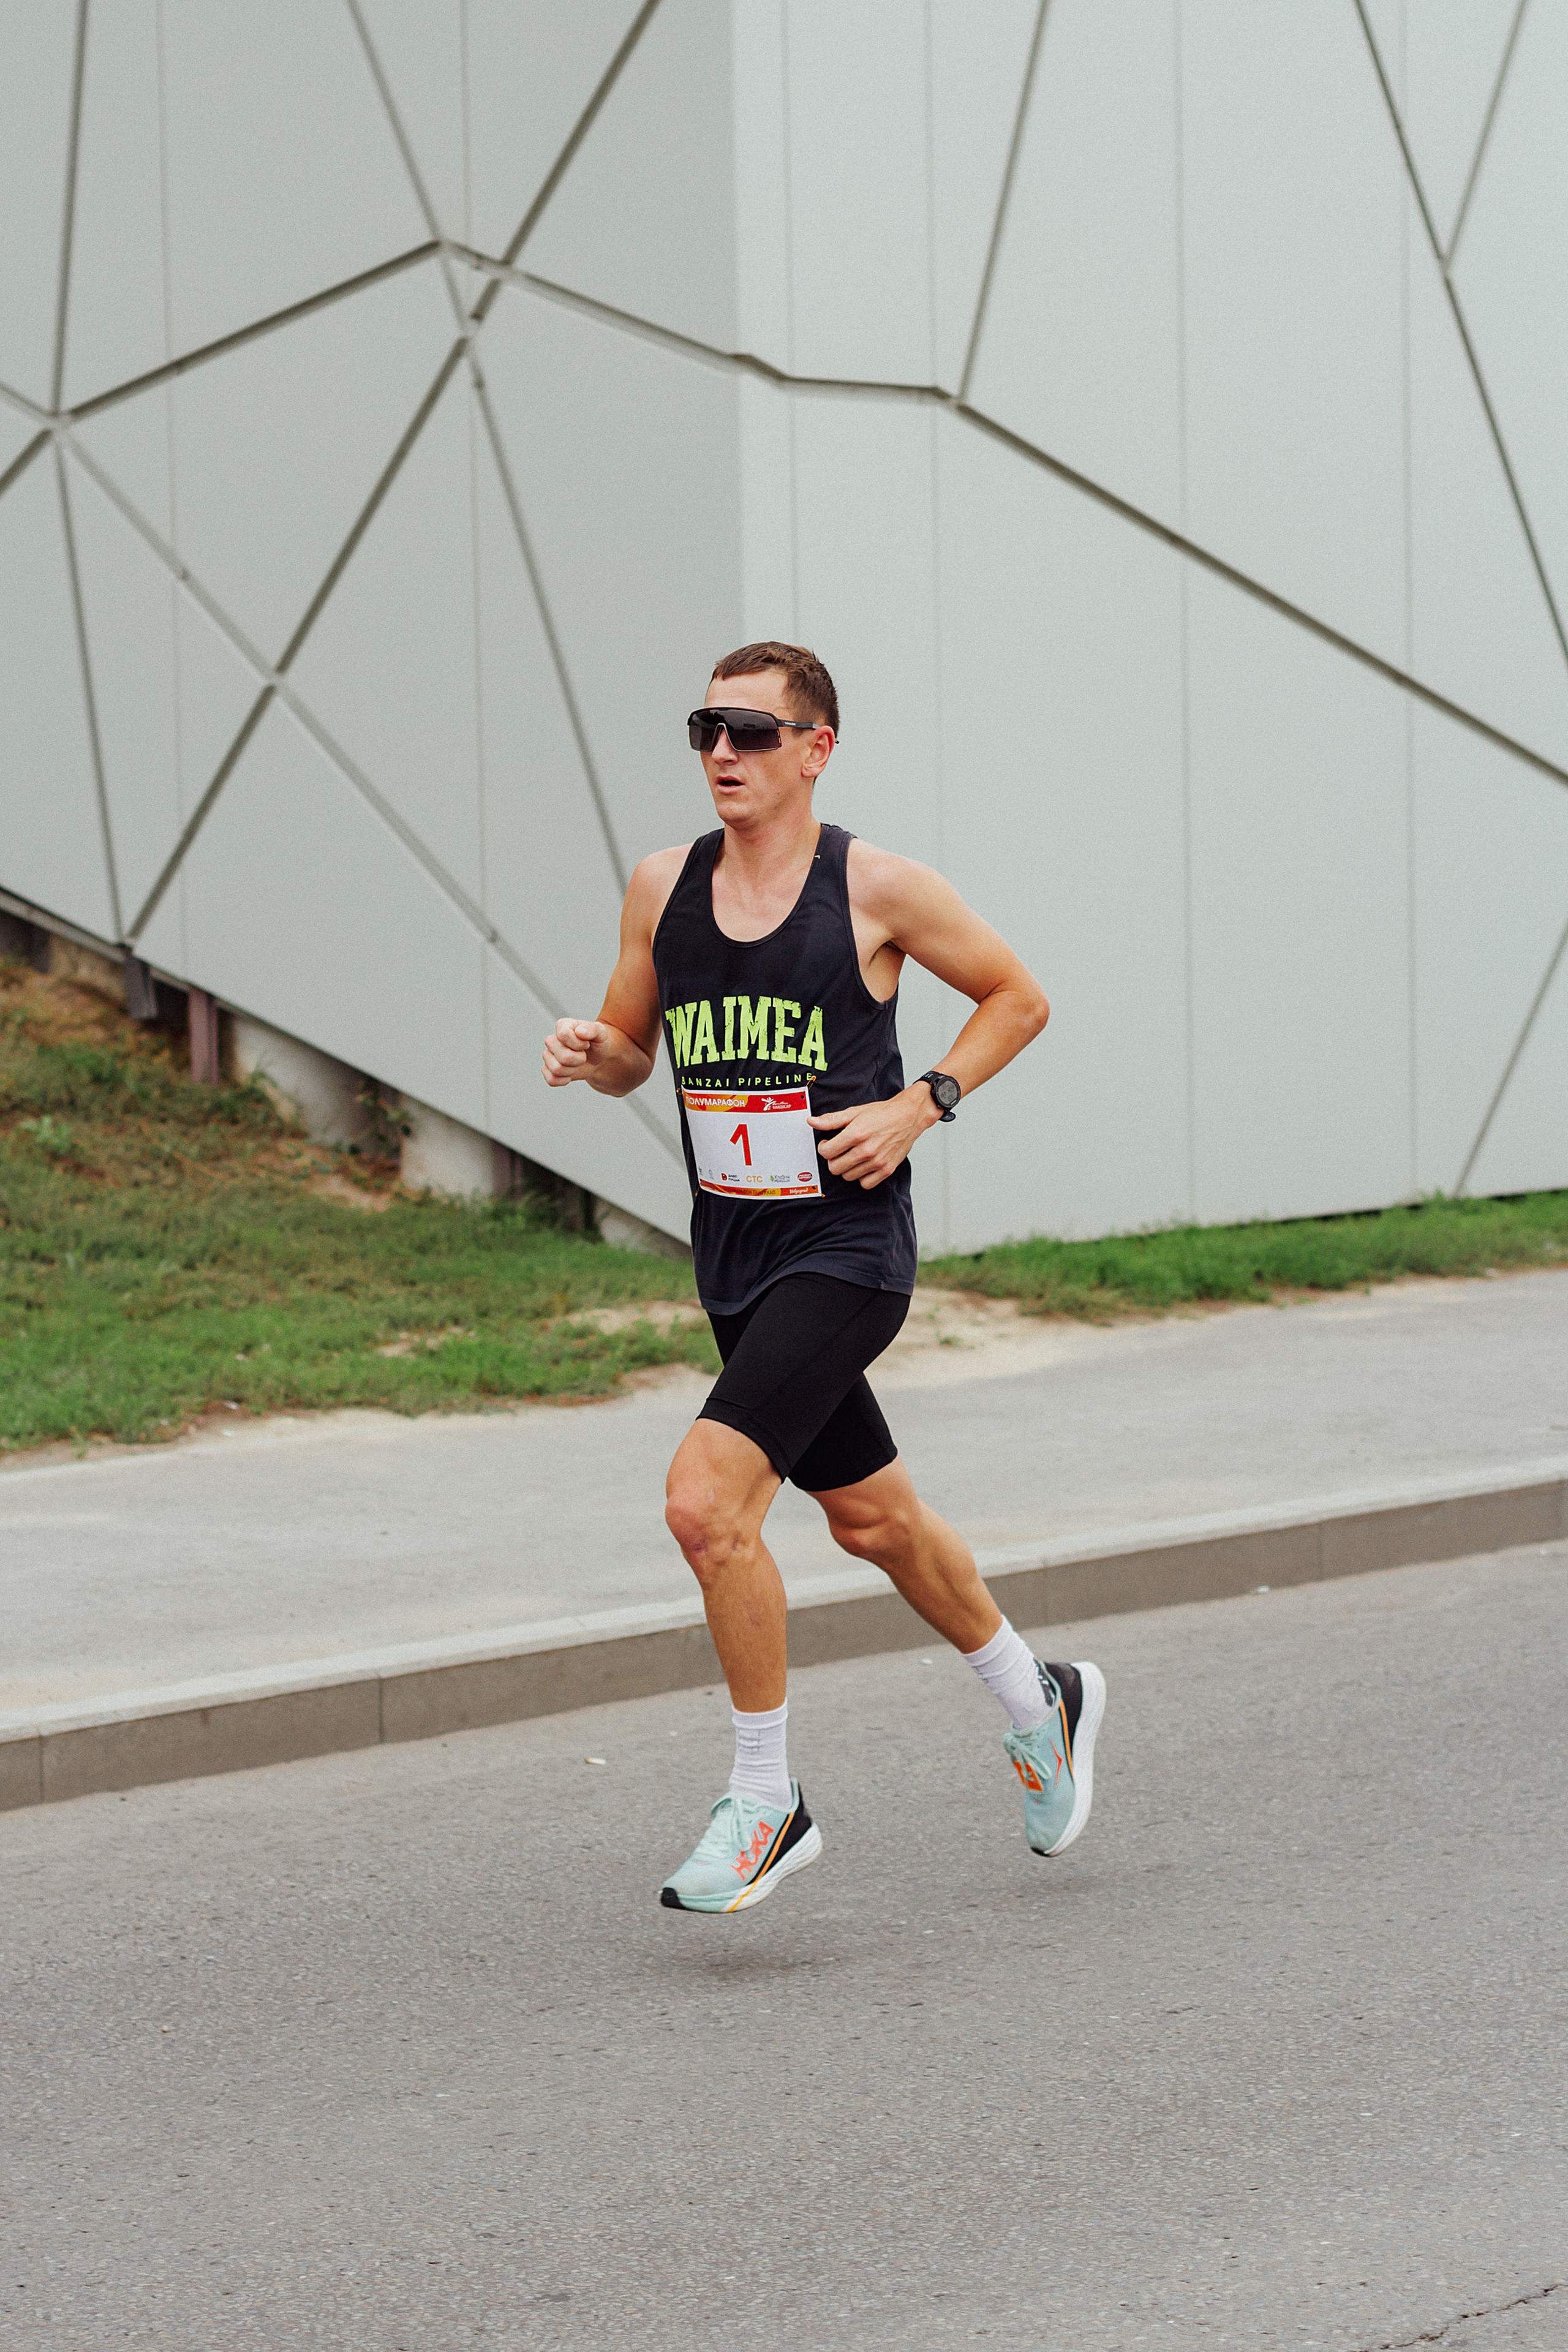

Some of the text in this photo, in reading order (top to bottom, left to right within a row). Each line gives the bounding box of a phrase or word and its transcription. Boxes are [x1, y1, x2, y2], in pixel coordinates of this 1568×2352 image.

[665, 995, 827, 1071] WAIMEA
[738, 1072, 812, 1087] PIPELINE
[729, 1124, 752, 1166] 1
